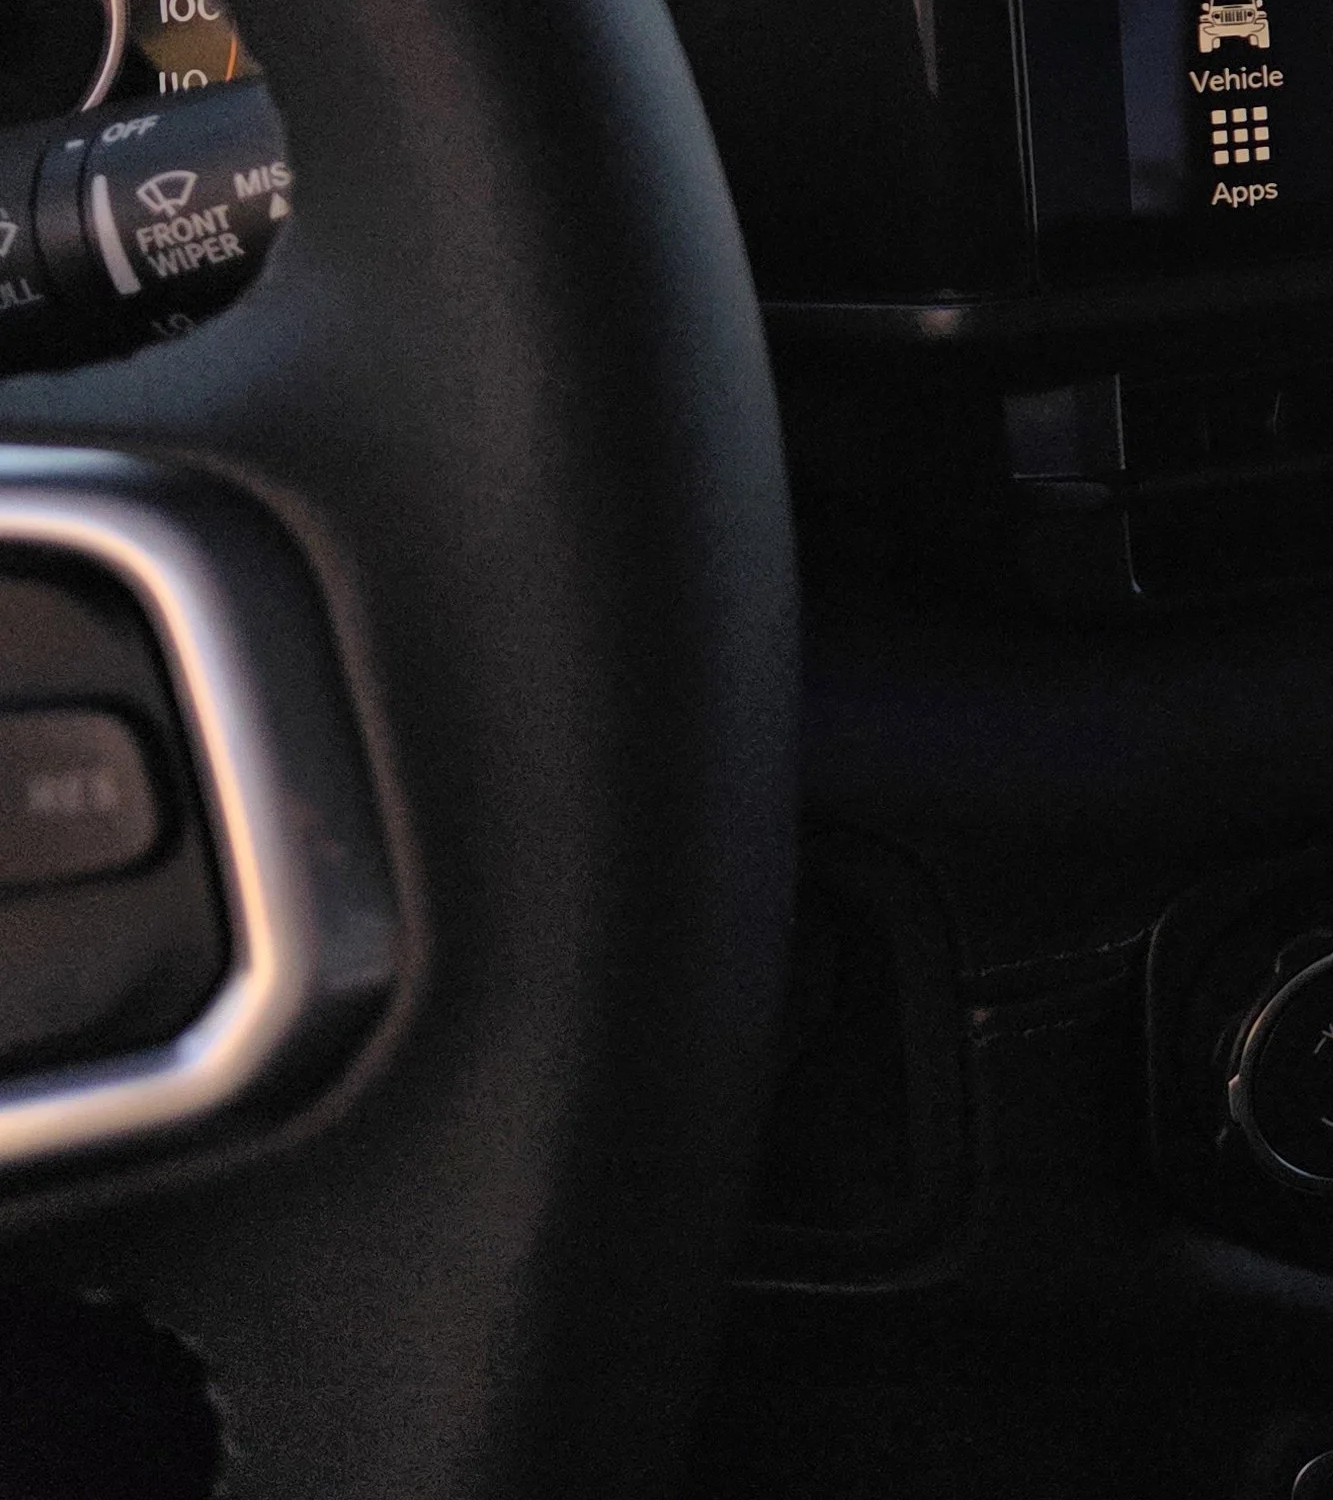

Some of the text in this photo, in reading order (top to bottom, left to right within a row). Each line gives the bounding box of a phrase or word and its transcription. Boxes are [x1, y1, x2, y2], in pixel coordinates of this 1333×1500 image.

[1189, 65, 1284, 93] Vehicle
[102, 114, 161, 143] OFF
[1211, 181, 1279, 208] Apps
[136, 204, 230, 253] FRONT
[148, 232, 246, 277] WIPER
